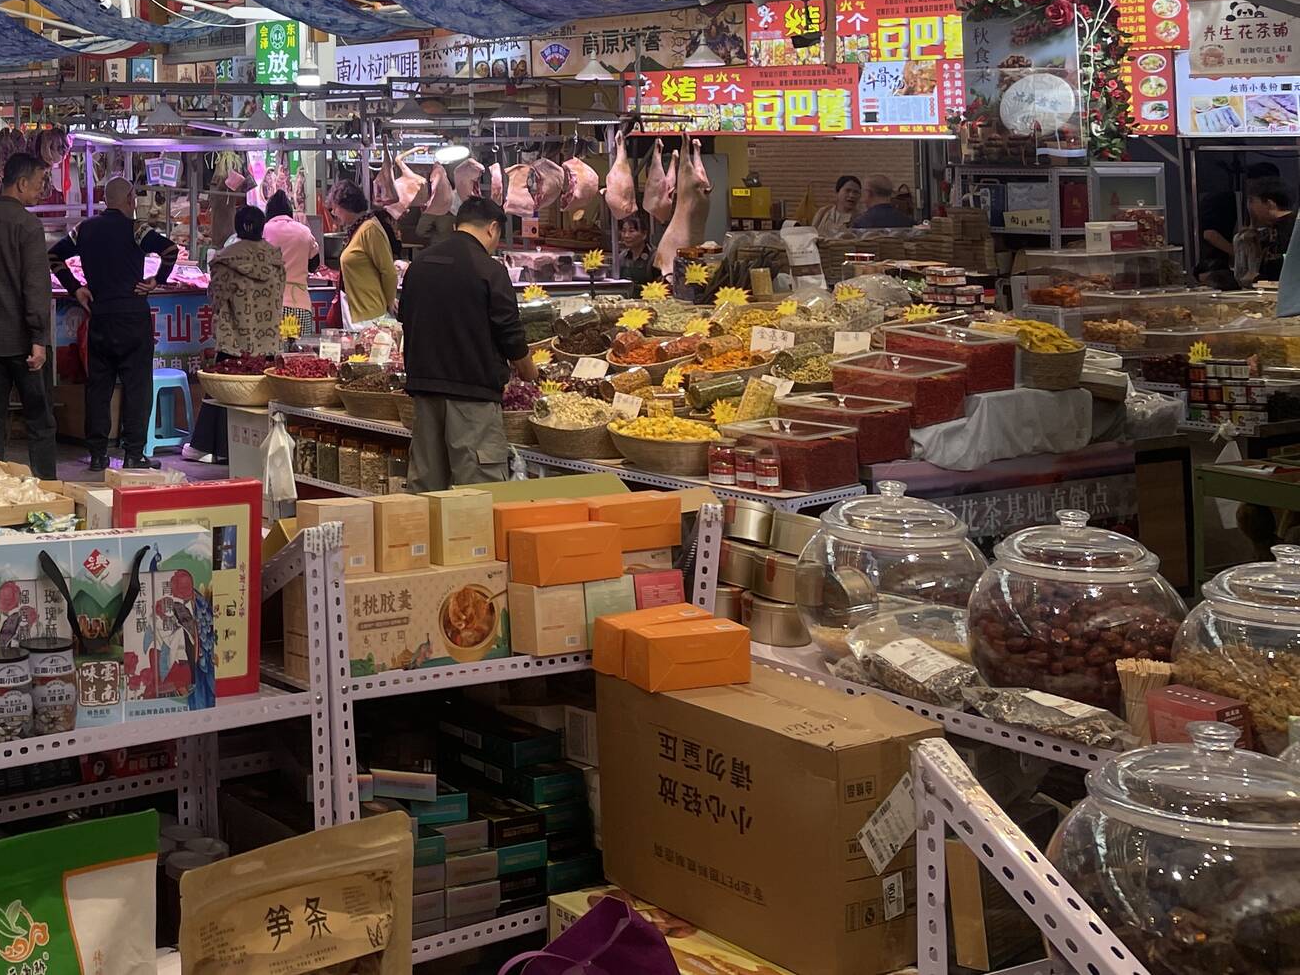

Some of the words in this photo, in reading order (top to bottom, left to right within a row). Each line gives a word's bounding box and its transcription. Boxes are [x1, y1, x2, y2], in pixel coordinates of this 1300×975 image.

[836, 0, 865, 11] 火气
[286, 23, 296, 48] 东川
[1203, 21, 1289, 41] 养生花茶铺
[660, 73, 697, 102] 烤
[701, 85, 744, 101] 了个
[942, 482, 1110, 532] 花茶基地直销点
[362, 588, 413, 616] 桃胶羹
[658, 731, 753, 792] 请勿重压
[658, 773, 753, 835] 小心轻放
[264, 896, 332, 952] 笋条
